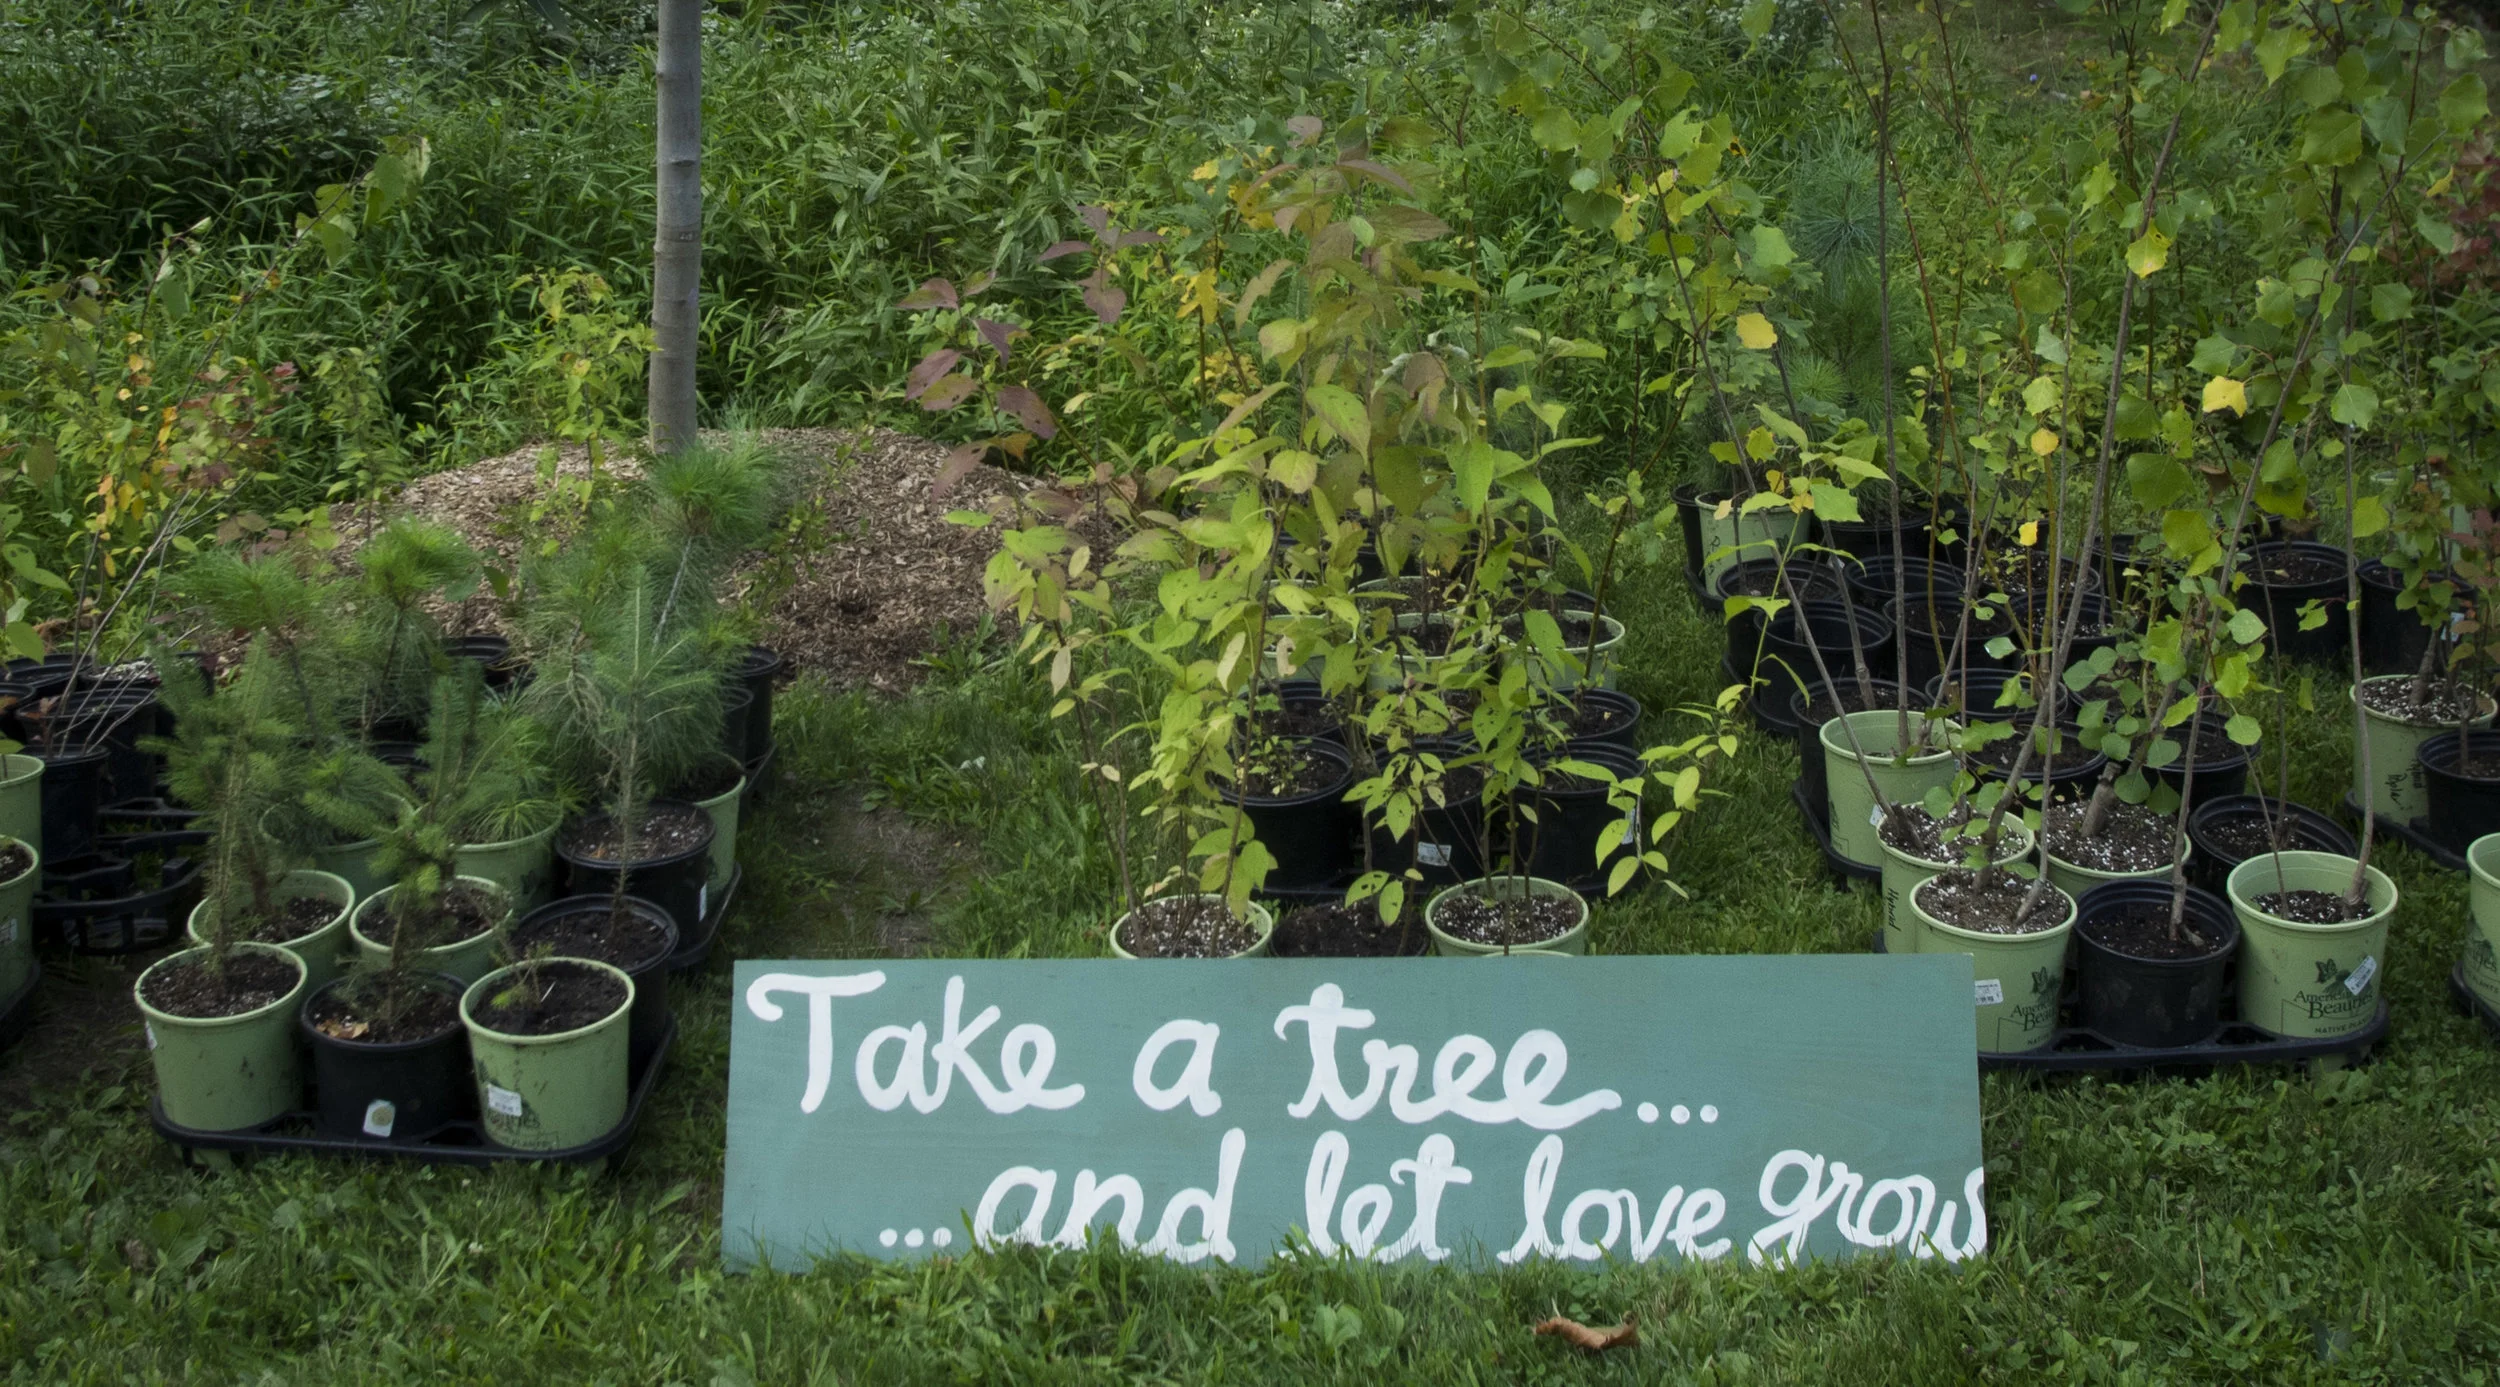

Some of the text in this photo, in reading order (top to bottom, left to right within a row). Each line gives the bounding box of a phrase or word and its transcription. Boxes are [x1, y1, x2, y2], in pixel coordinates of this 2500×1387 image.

[747, 971, 1085, 1115] Take
[1133, 1019, 1222, 1117] a
[1279, 1130, 1473, 1264] let
[1497, 1133, 1732, 1264] love
[1747, 1149, 1988, 1271] grow
